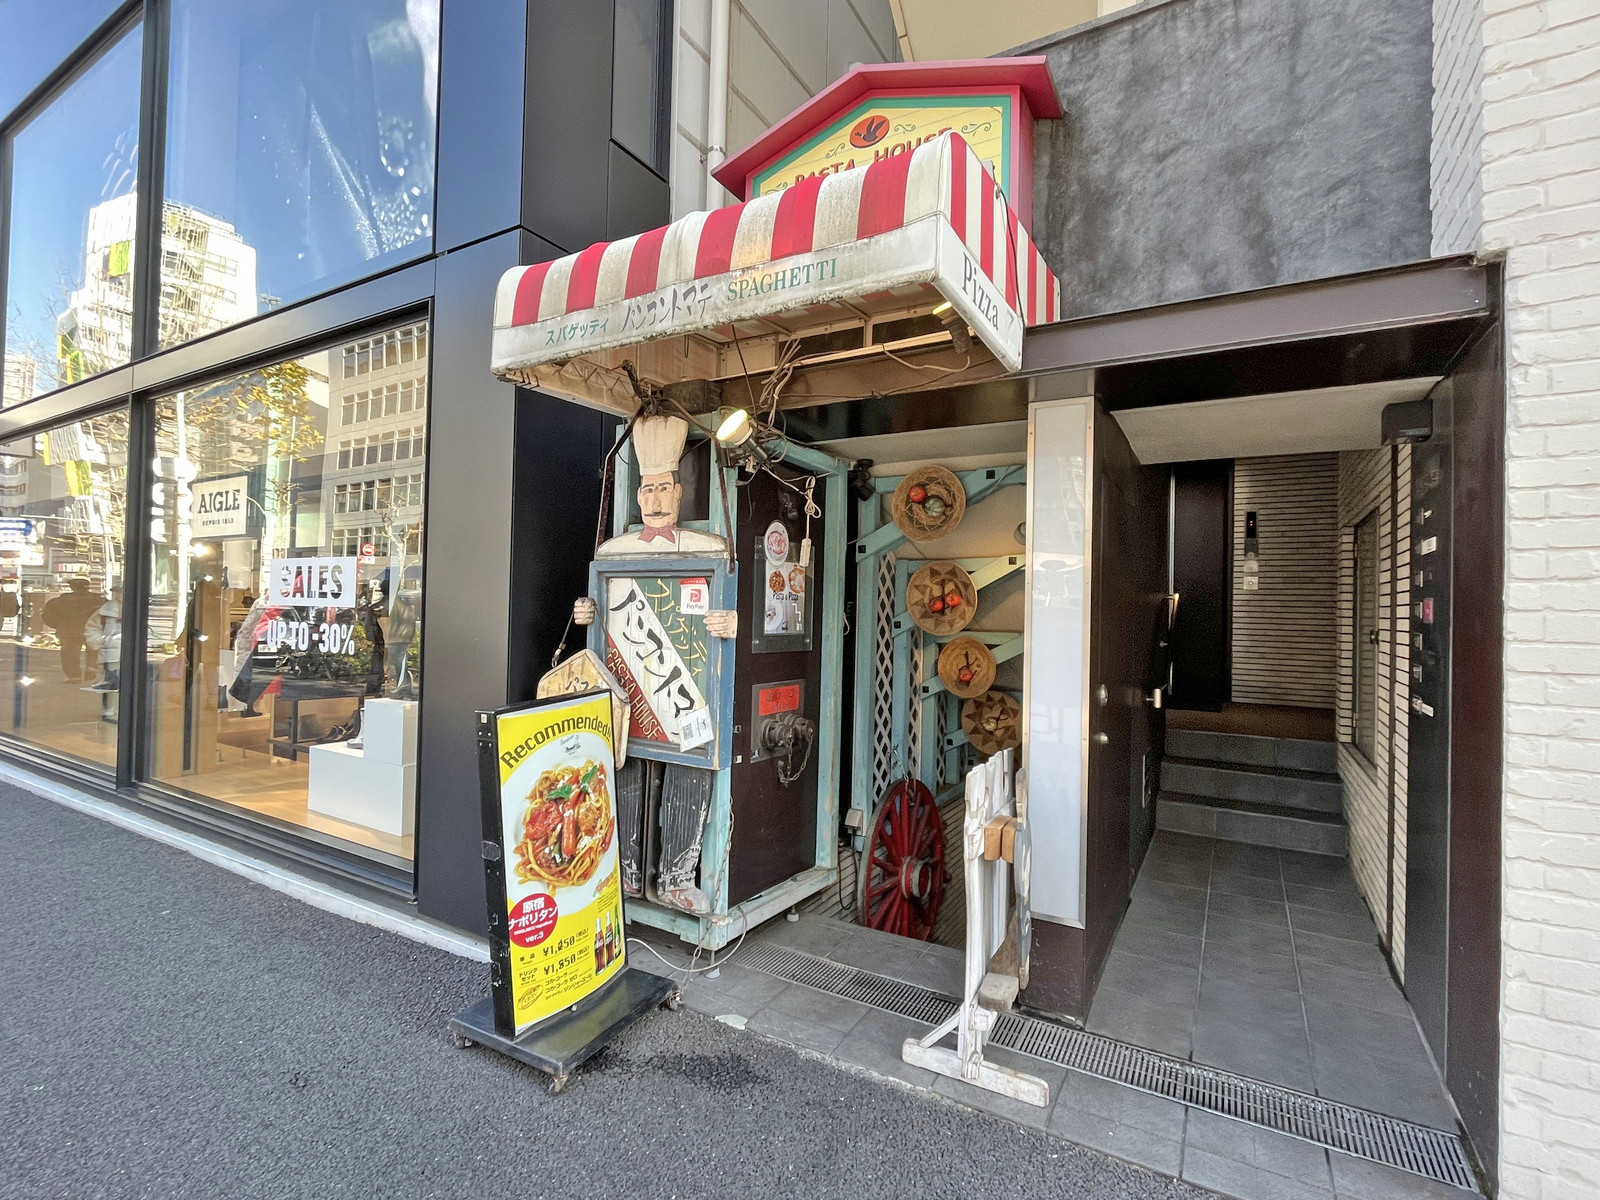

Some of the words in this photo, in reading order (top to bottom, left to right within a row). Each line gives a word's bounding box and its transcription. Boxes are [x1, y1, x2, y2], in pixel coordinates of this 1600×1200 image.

[795, 158, 856, 185] PSTA
[727, 257, 838, 301] SPAGHETTI
[961, 251, 999, 331] Pizza
[620, 283, 712, 334] パンコントマテ
[545, 318, 609, 346] スパゲッティ
[197, 489, 241, 515] AIGLE
[280, 564, 343, 600] SALES
[686, 603, 704, 611] PayPay
[312, 623, 355, 656] -30%
[609, 588, 696, 735] パンコントマ
[630, 693, 664, 741] HOUSE
[508, 905, 558, 930] ナポリタン
[522, 896, 545, 914] 原宿
[525, 931, 544, 943] ver.3
